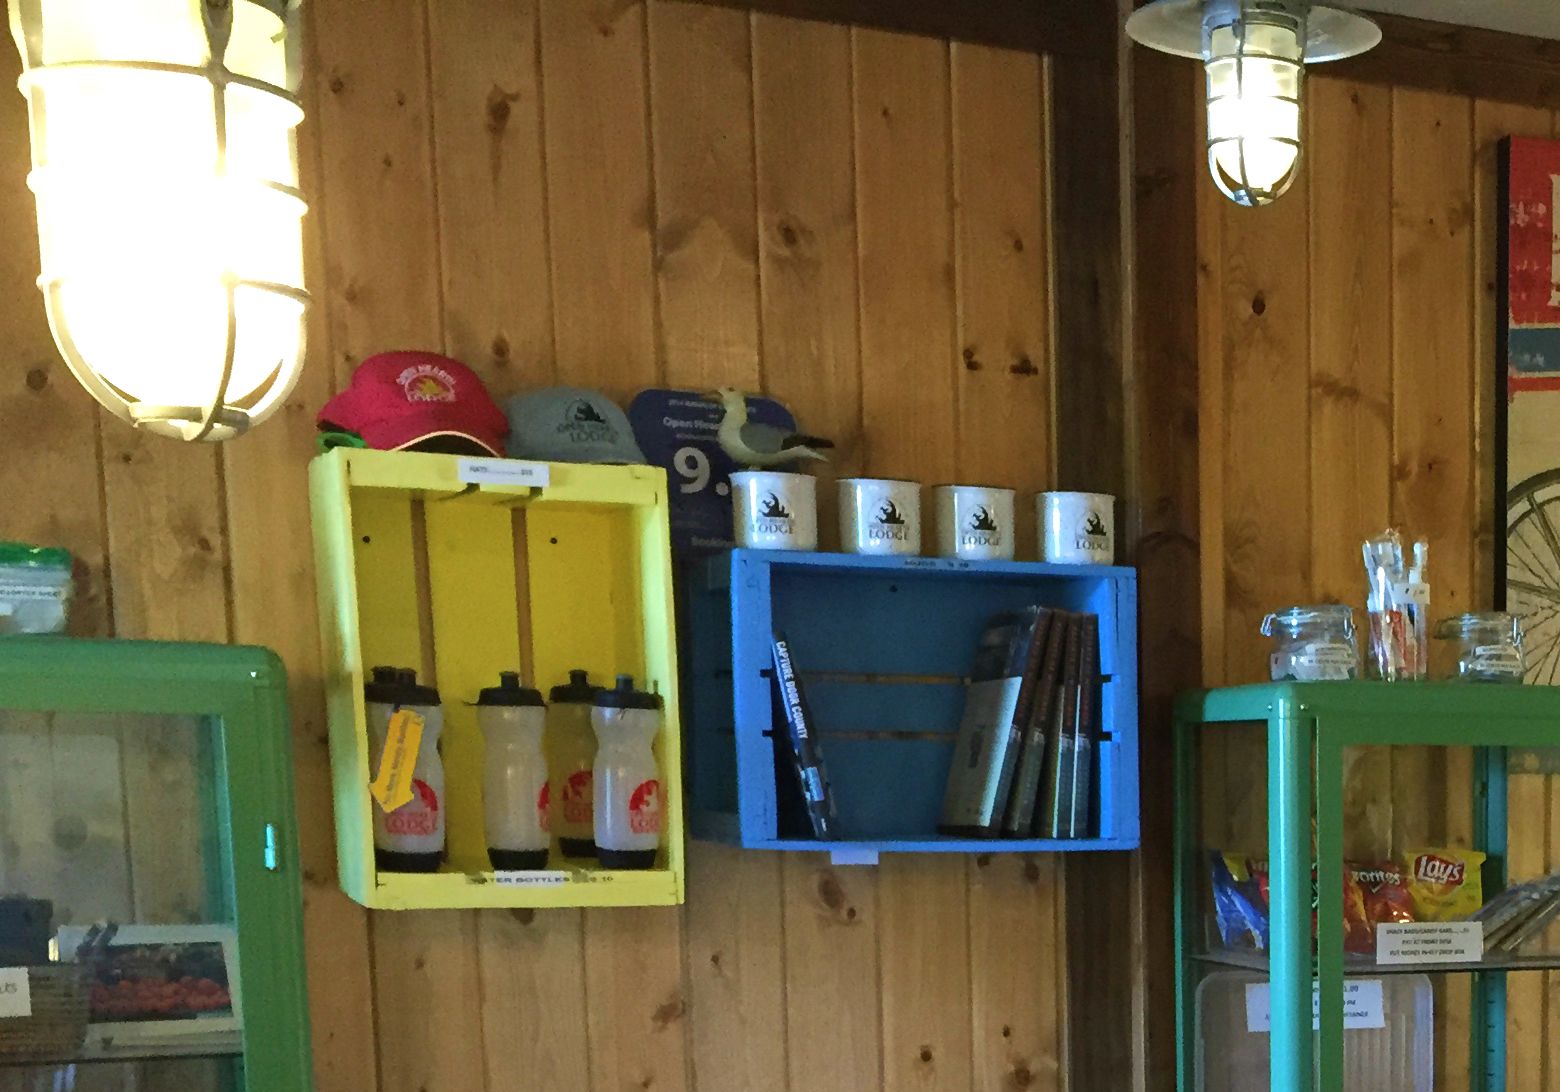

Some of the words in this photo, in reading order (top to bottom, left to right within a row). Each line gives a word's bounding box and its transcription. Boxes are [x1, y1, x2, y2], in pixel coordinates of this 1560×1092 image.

[776, 641, 794, 681] CAPTURE
[786, 681, 800, 705] DOOR
[791, 705, 808, 739] COUNTY
